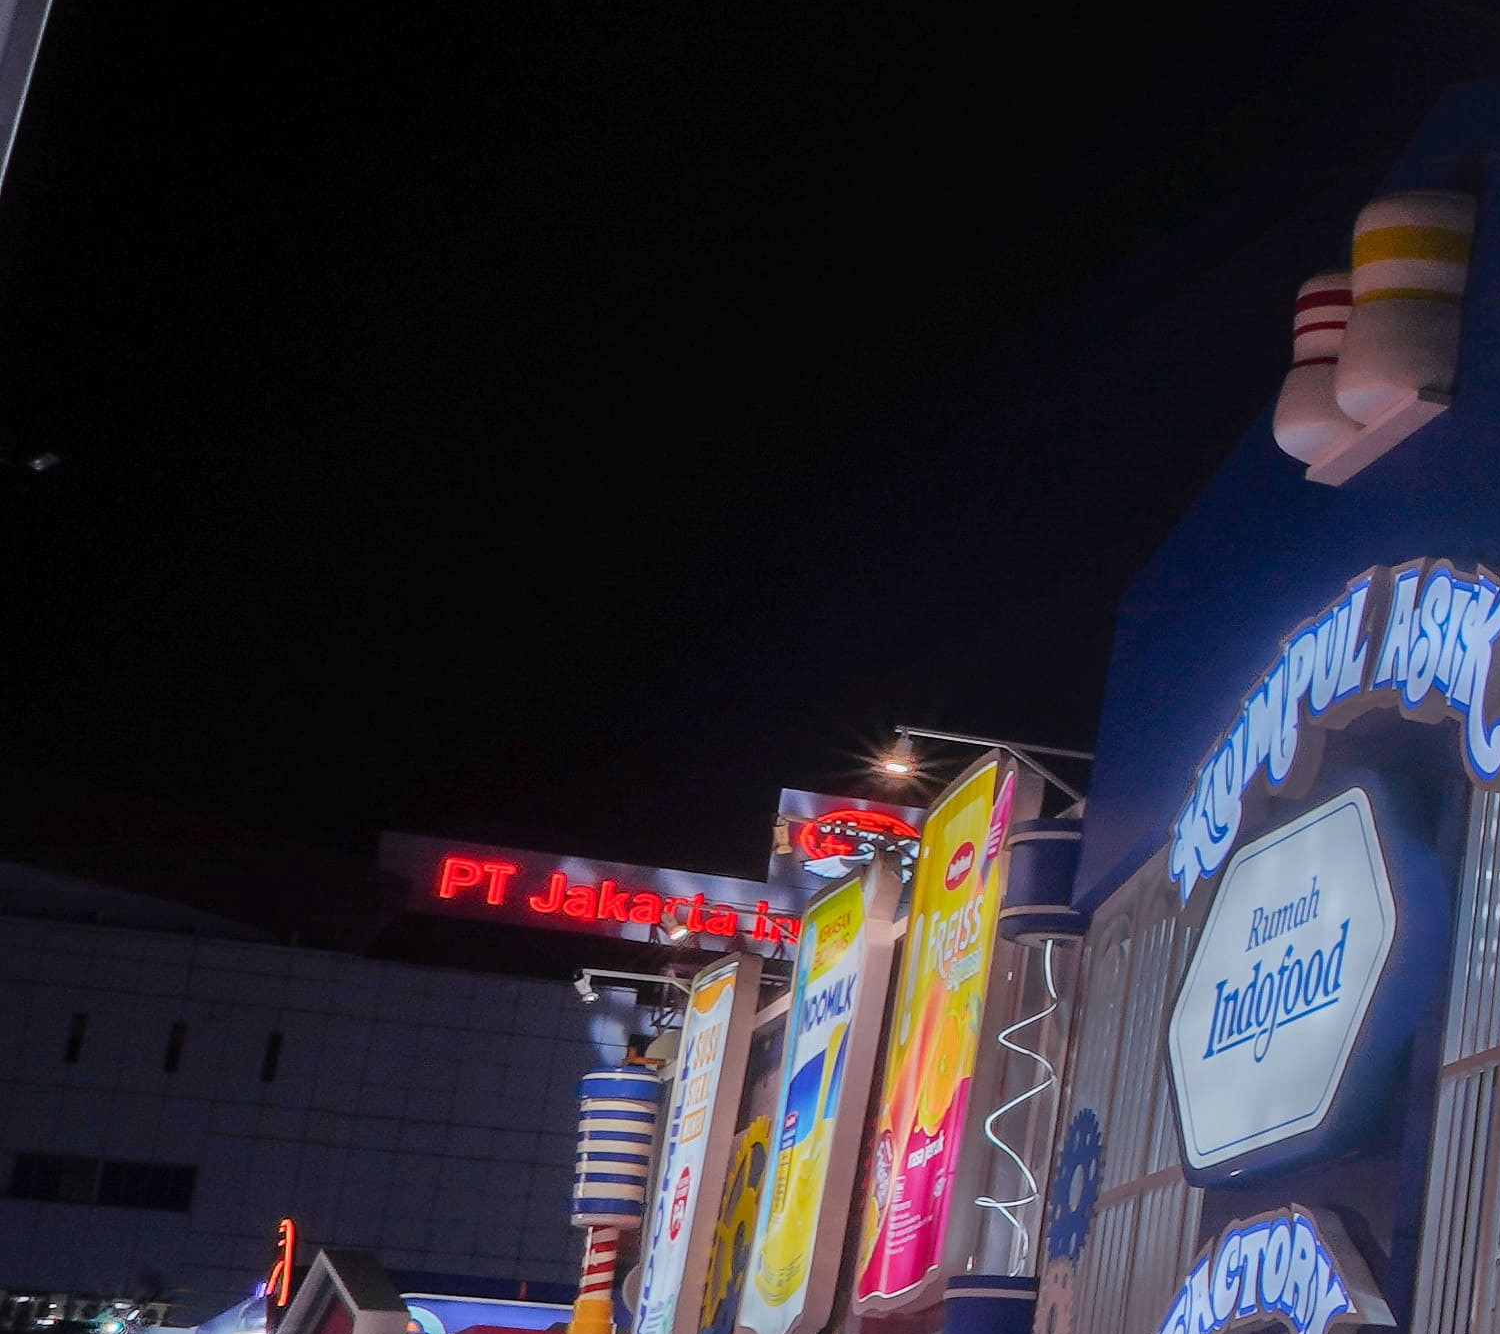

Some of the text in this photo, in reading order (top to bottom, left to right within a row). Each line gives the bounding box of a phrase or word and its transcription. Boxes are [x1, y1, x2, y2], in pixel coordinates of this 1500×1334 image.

[1169, 572, 1374, 909] KUMPUL
[438, 856, 520, 907] PT
[1245, 873, 1323, 956] Rumah
[1201, 917, 1350, 1065] Indofood
